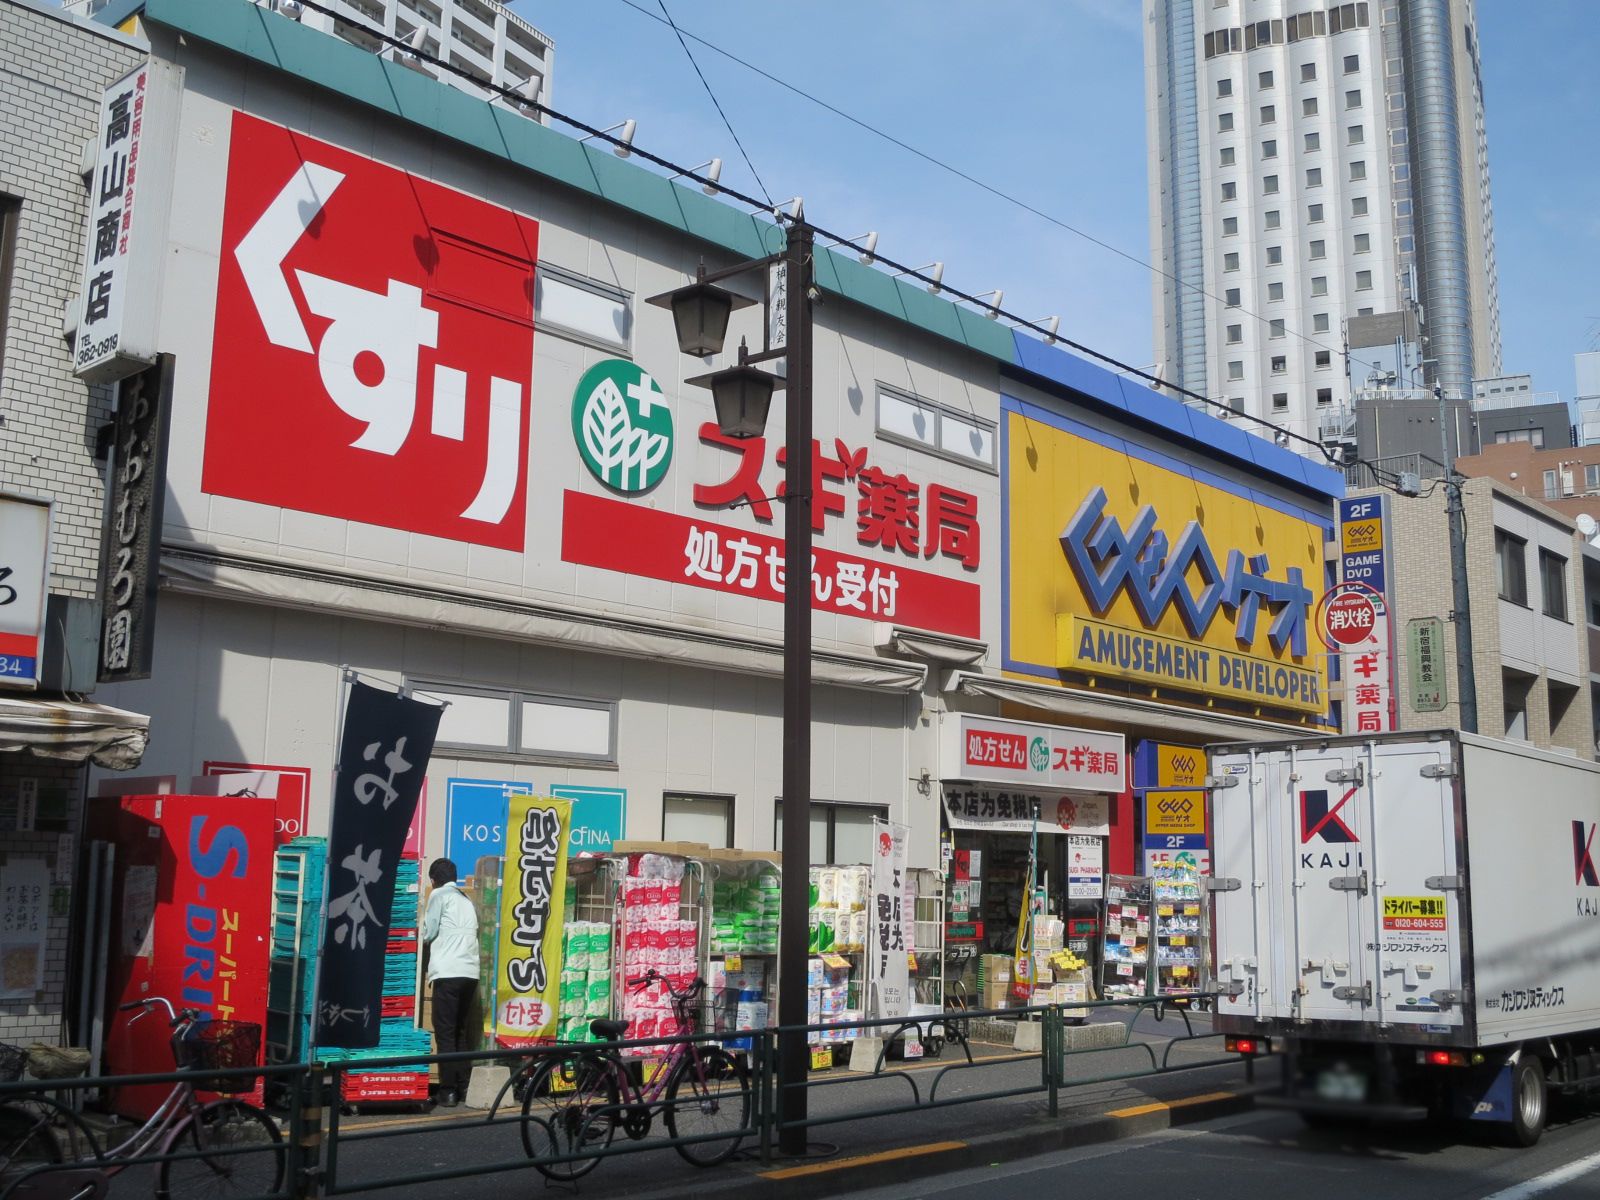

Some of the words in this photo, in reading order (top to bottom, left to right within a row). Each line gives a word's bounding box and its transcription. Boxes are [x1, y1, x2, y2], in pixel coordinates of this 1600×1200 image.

[84, 89, 133, 326] 高山商店
[81, 334, 92, 348] TEL
[234, 160, 522, 525] くすり
[77, 333, 118, 367] 362-0919
[1350, 503, 1372, 518] 2F
[1345, 554, 1381, 567] GAME
[1347, 568, 1372, 579] DVD
[1220, 548, 1314, 658] ゲオ
[1330, 608, 1372, 630] 消火栓
[1078, 626, 1209, 684] AMUSEMENT
[1219, 659, 1320, 706] DEVELOPER
[969, 735, 1025, 764] 処方せん
[1053, 746, 1119, 776] スギ薬局
[1176, 815, 1191, 823] ゲオ
[1166, 835, 1185, 848] 2F
[1301, 852, 1363, 869] KAJI
[1384, 899, 1443, 915] ドライバー募集!!
[1395, 918, 1444, 928] 0120-604-555
